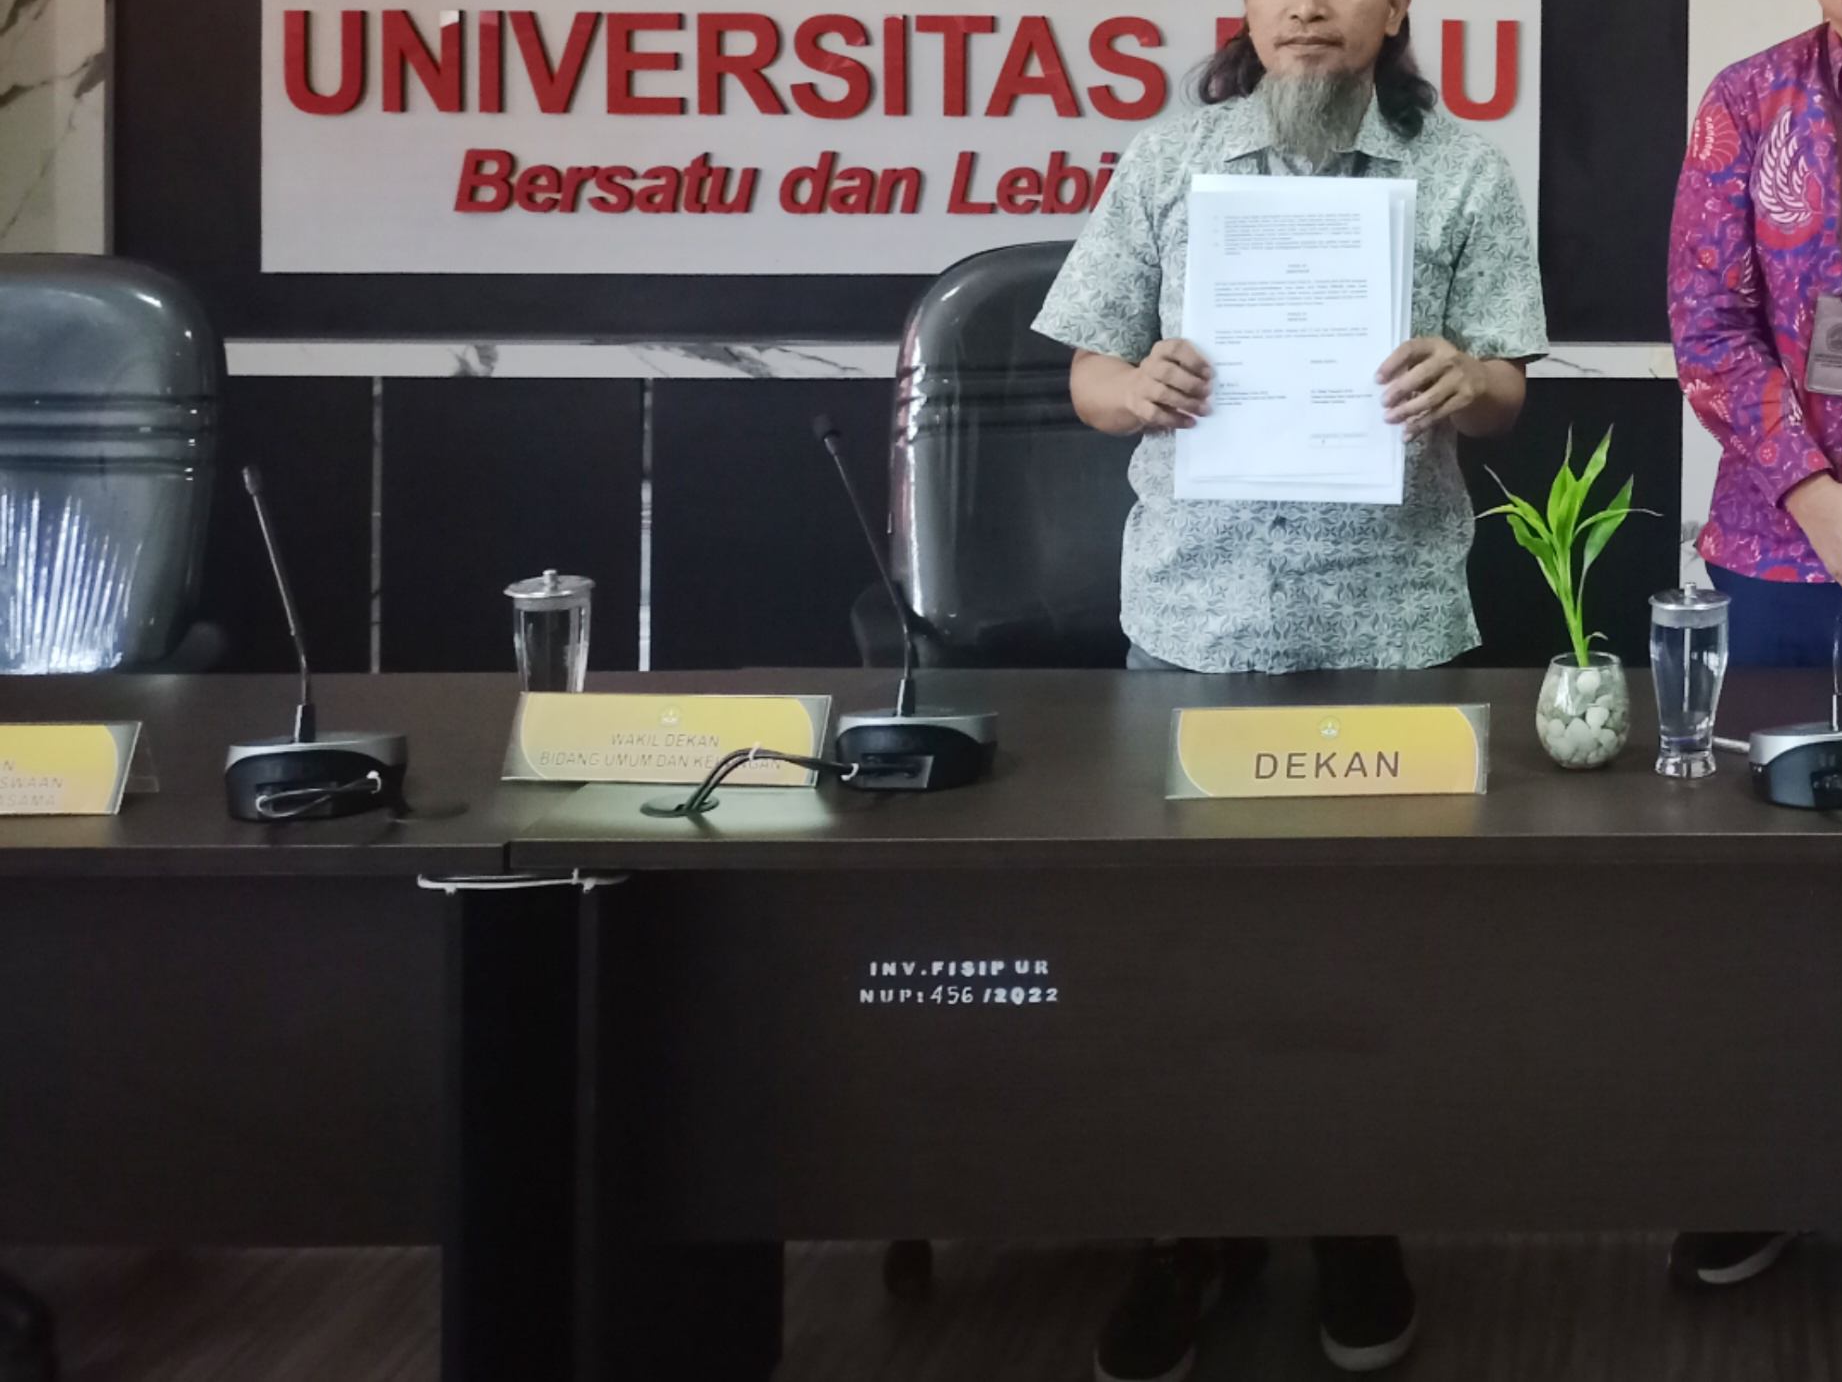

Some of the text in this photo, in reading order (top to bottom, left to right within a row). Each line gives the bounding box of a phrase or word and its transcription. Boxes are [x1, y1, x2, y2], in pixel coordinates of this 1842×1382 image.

[282, 9, 1168, 121] UNIVERSITAS
[454, 149, 1117, 216] Bersatu dan Lebi
[611, 732, 720, 749] WAKIL DEKAN
[539, 751, 600, 767] BIDANG
[604, 753, 652, 768] UMUM
[655, 753, 689, 768] DAN
[1254, 750, 1400, 780] DEKAN
[1014, 959, 1049, 975] UR
